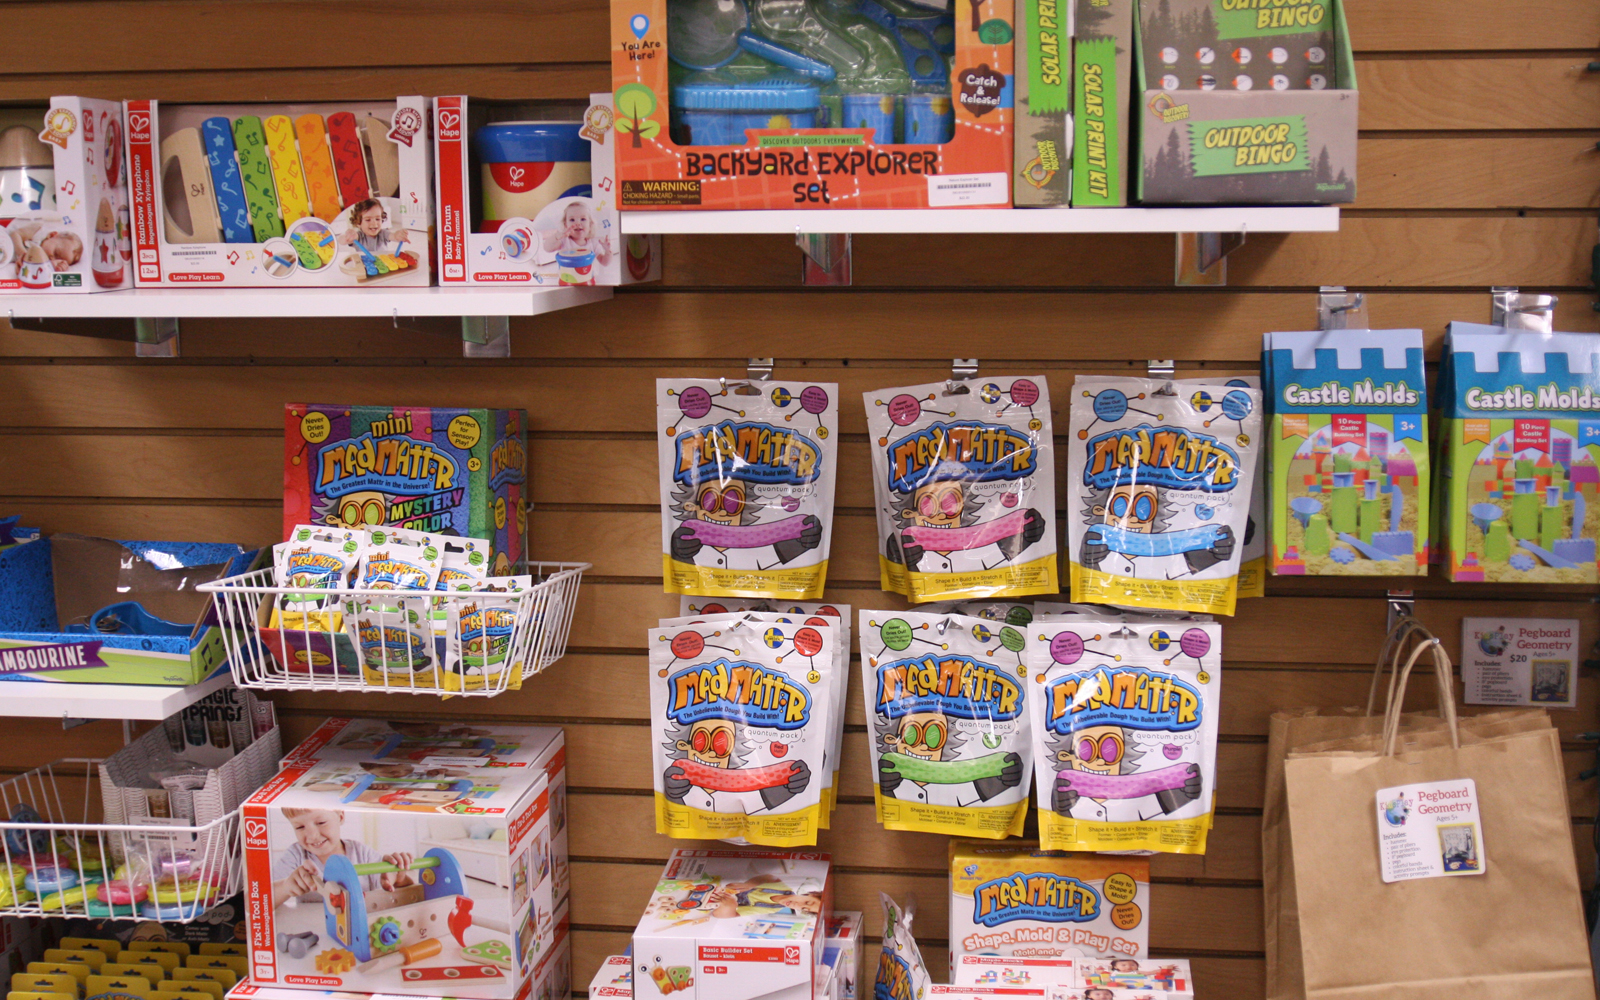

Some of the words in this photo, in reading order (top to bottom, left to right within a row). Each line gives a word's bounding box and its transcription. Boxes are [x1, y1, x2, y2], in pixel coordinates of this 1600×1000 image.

[1257, 5, 1324, 30] BINGO
[621, 42, 640, 52] You
[642, 40, 661, 49] Are
[629, 49, 655, 61] Here!
[966, 74, 997, 87] Catch
[977, 86, 985, 95] &
[1083, 63, 1103, 117] SOLAR
[960, 94, 1001, 105] Release!
[1340, 93, 1350, 101] 3+
[130, 132, 150, 141] Hape
[440, 129, 459, 137] Hape
[587, 131, 599, 140] BABY
[1204, 123, 1290, 149] OUTDOOR
[48, 135, 62, 145] BABY
[792, 137, 821, 145] OUTDOORS
[1086, 118, 1107, 169] PRINT
[1235, 142, 1297, 167] BINGO
[135, 154, 144, 203] Xylophone
[642, 182, 700, 191] WARNING:
[1088, 170, 1108, 199] KIT
[137, 205, 146, 245] Rainbow
[147, 203, 155, 245] Regenbogen
[445, 234, 454, 260] Baby
[189, 274, 204, 282] Play
[1285, 380, 1350, 405] Castle
[1354, 378, 1417, 405] Molds
[1467, 387, 1533, 409] Castle
[1538, 383, 1600, 409] Molds
[305, 416, 324, 425] Never
[371, 411, 413, 439] mini
[455, 419, 476, 429] Perfect
[306, 423, 325, 431] Dries
[1402, 422, 1415, 431] 3+
[309, 430, 324, 438] Out!
[451, 431, 475, 442] Sensory
[455, 438, 469, 447] Play!
[470, 460, 480, 468] 3+
[330, 485, 341, 494] The
[342, 479, 366, 490] Greatest
[367, 478, 384, 487] Mattr
[402, 481, 430, 490] Universe!
[390, 487, 464, 522] MYSTERY
[403, 512, 452, 531] COLOR
[1519, 628, 1571, 639] Pegboard
[1517, 640, 1572, 651] Geometry
[1510, 654, 1528, 663] $20
[693, 706, 723, 716] Unbelievable
[724, 707, 741, 715] Dough
[752, 712, 766, 720] Build
[958, 721, 991, 729] quantum
[747, 729, 778, 737] quantum
[780, 731, 799, 739] pack
[1136, 733, 1171, 741] quantum
[1173, 733, 1193, 741] pack
[1418, 787, 1469, 803] Pegboard
[1418, 803, 1472, 815] Geometry
[247, 837, 267, 846] Hape
[1110, 878, 1123, 886] Easy
[1108, 884, 1127, 893] Shape
[1111, 891, 1128, 900] Mold!
[253, 901, 261, 920] Tool
[1116, 906, 1134, 914] Never
[263, 894, 271, 947] Werkzeugkasten
[988, 915, 998, 923] The
[998, 910, 1020, 920] Greatest
[254, 922, 262, 946] Fix-It
[963, 932, 1015, 952] Shape,
[1015, 928, 1054, 943] Mold
[1058, 928, 1070, 942] &
[1074, 930, 1109, 952] Play
[1111, 937, 1139, 956] Set
[1014, 948, 1036, 956] Mold
[1037, 948, 1055, 956] and
